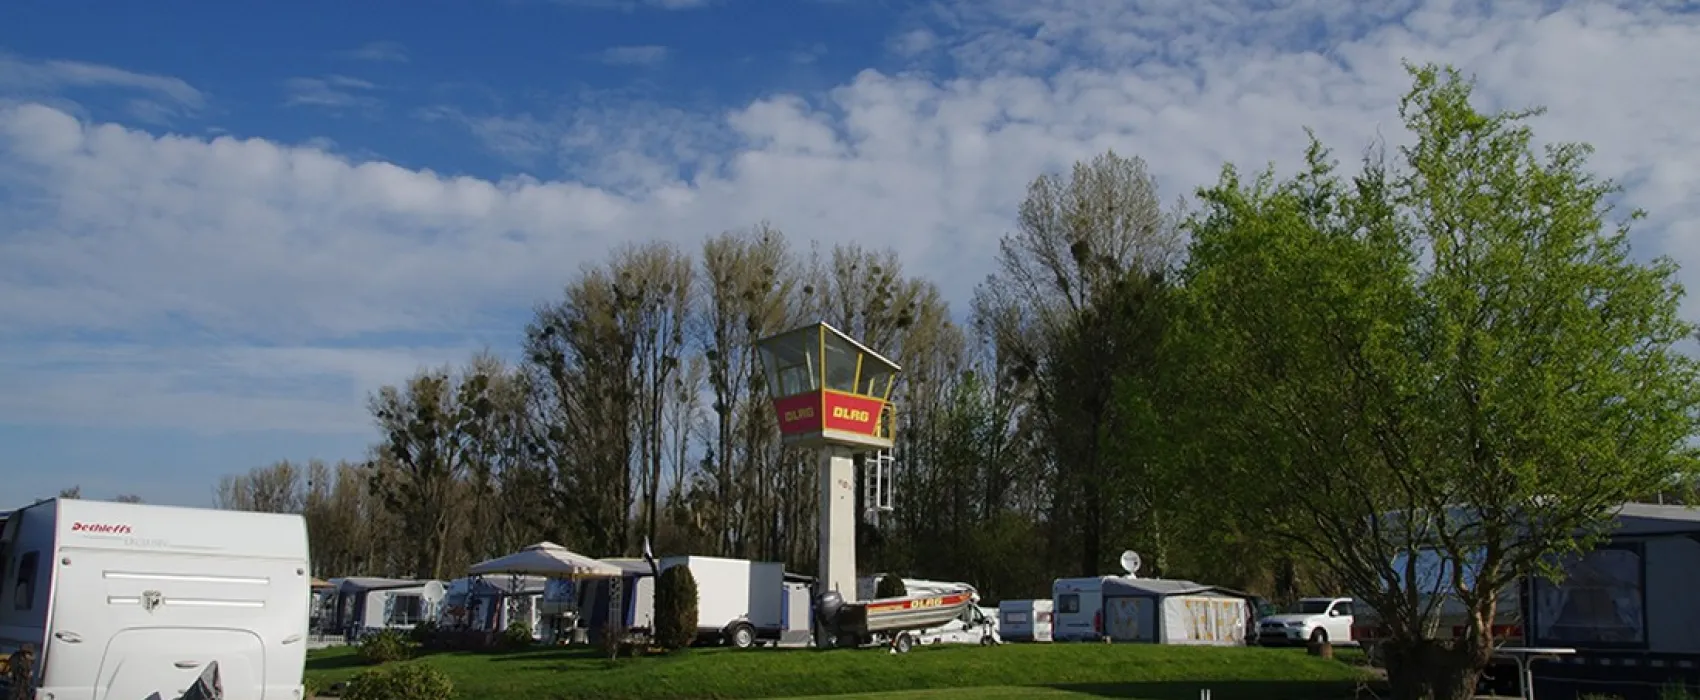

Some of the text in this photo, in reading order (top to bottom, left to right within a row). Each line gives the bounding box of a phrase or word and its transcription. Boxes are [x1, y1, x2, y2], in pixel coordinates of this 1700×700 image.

[784, 407, 814, 422] DLRG
[833, 406, 870, 422] DLRG
[72, 522, 132, 534] Dethleffs
[911, 597, 942, 609] DLRG
